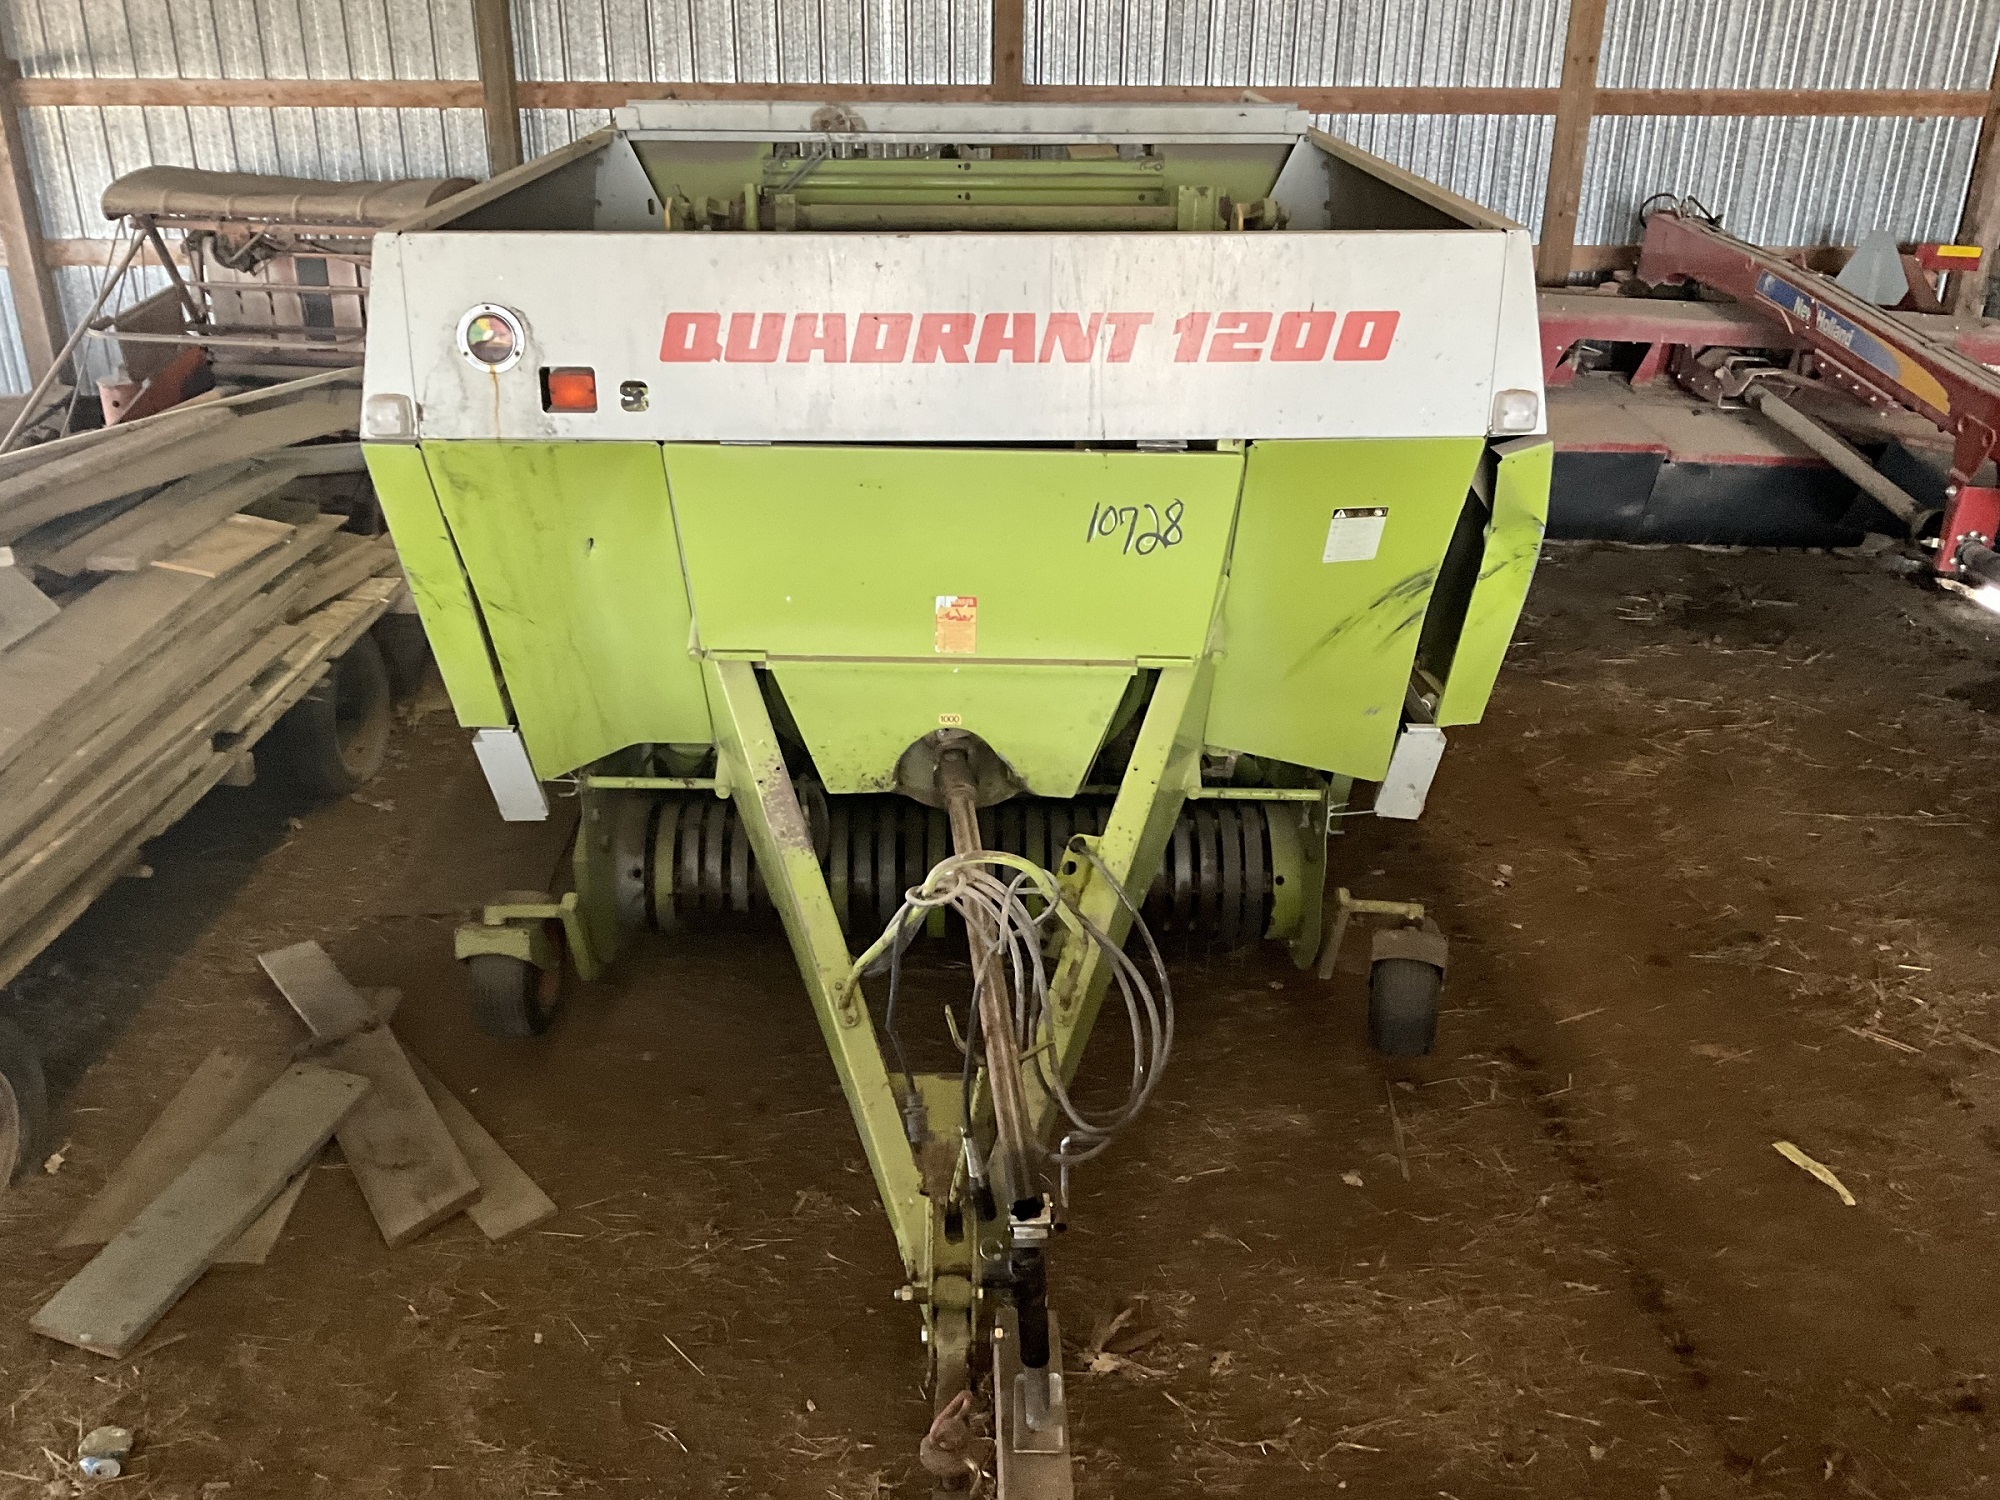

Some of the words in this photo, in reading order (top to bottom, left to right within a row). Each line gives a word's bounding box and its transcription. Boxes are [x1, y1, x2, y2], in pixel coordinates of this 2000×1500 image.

[659, 312, 1152, 363] QUADRANT
[1172, 312, 1401, 362] 1200
[1816, 310, 1855, 347] Holland
[1086, 498, 1184, 555] 10728
[940, 715, 960, 723] 1000
